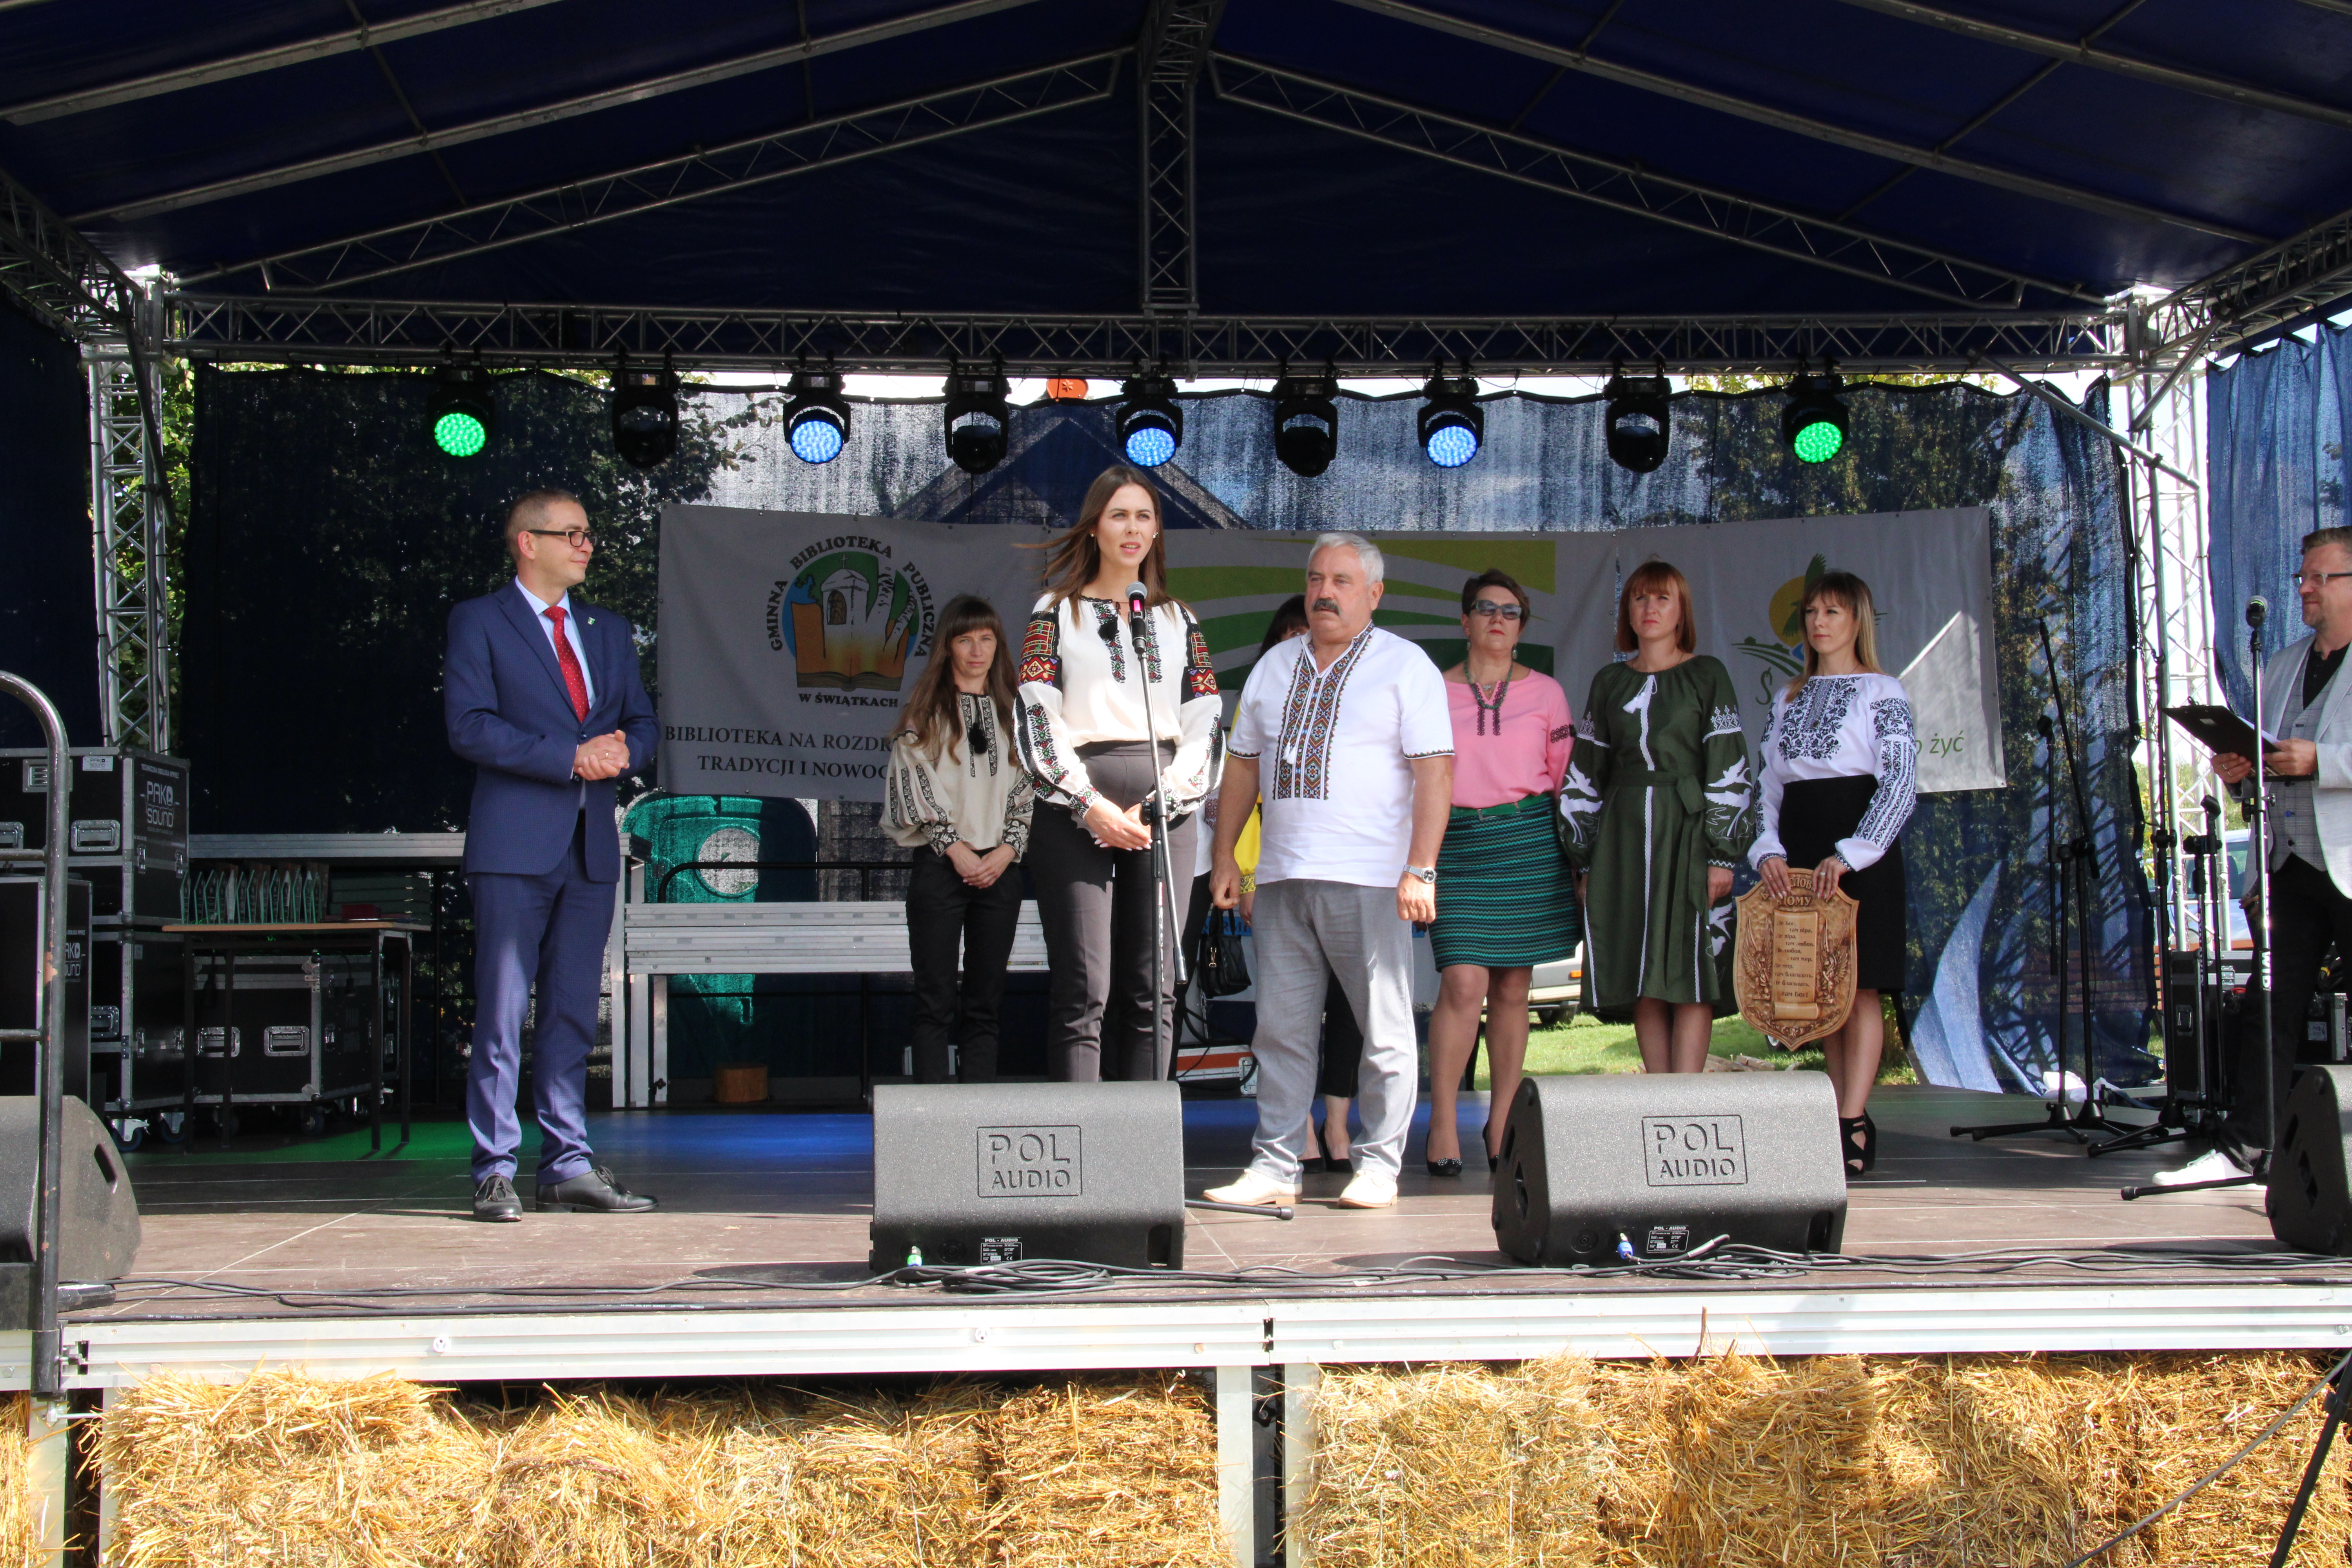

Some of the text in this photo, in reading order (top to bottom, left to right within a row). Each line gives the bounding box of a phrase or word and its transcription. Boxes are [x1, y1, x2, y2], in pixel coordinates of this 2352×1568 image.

[789, 535, 892, 570] BIBLIOTEKA
[766, 580, 788, 651] GMINNA
[902, 561, 935, 657] PUBLICZNA
[799, 692, 898, 708] W ŚWIĄTKACH
[666, 725, 784, 746] BIBLIOTEKA
[789, 732, 817, 748] NA
[1929, 730, 1965, 759] żyć
[697, 755, 795, 777] TRADYCJI
[800, 760, 807, 775] I
[147, 781, 173, 806] PAKO
[65, 942, 81, 959] AKO
[988, 1134, 1070, 1165] POL
[1653, 1123, 1734, 1154] POL
[991, 1169, 1070, 1189] AUDIO
[1660, 1158, 1735, 1178] AUDIO
